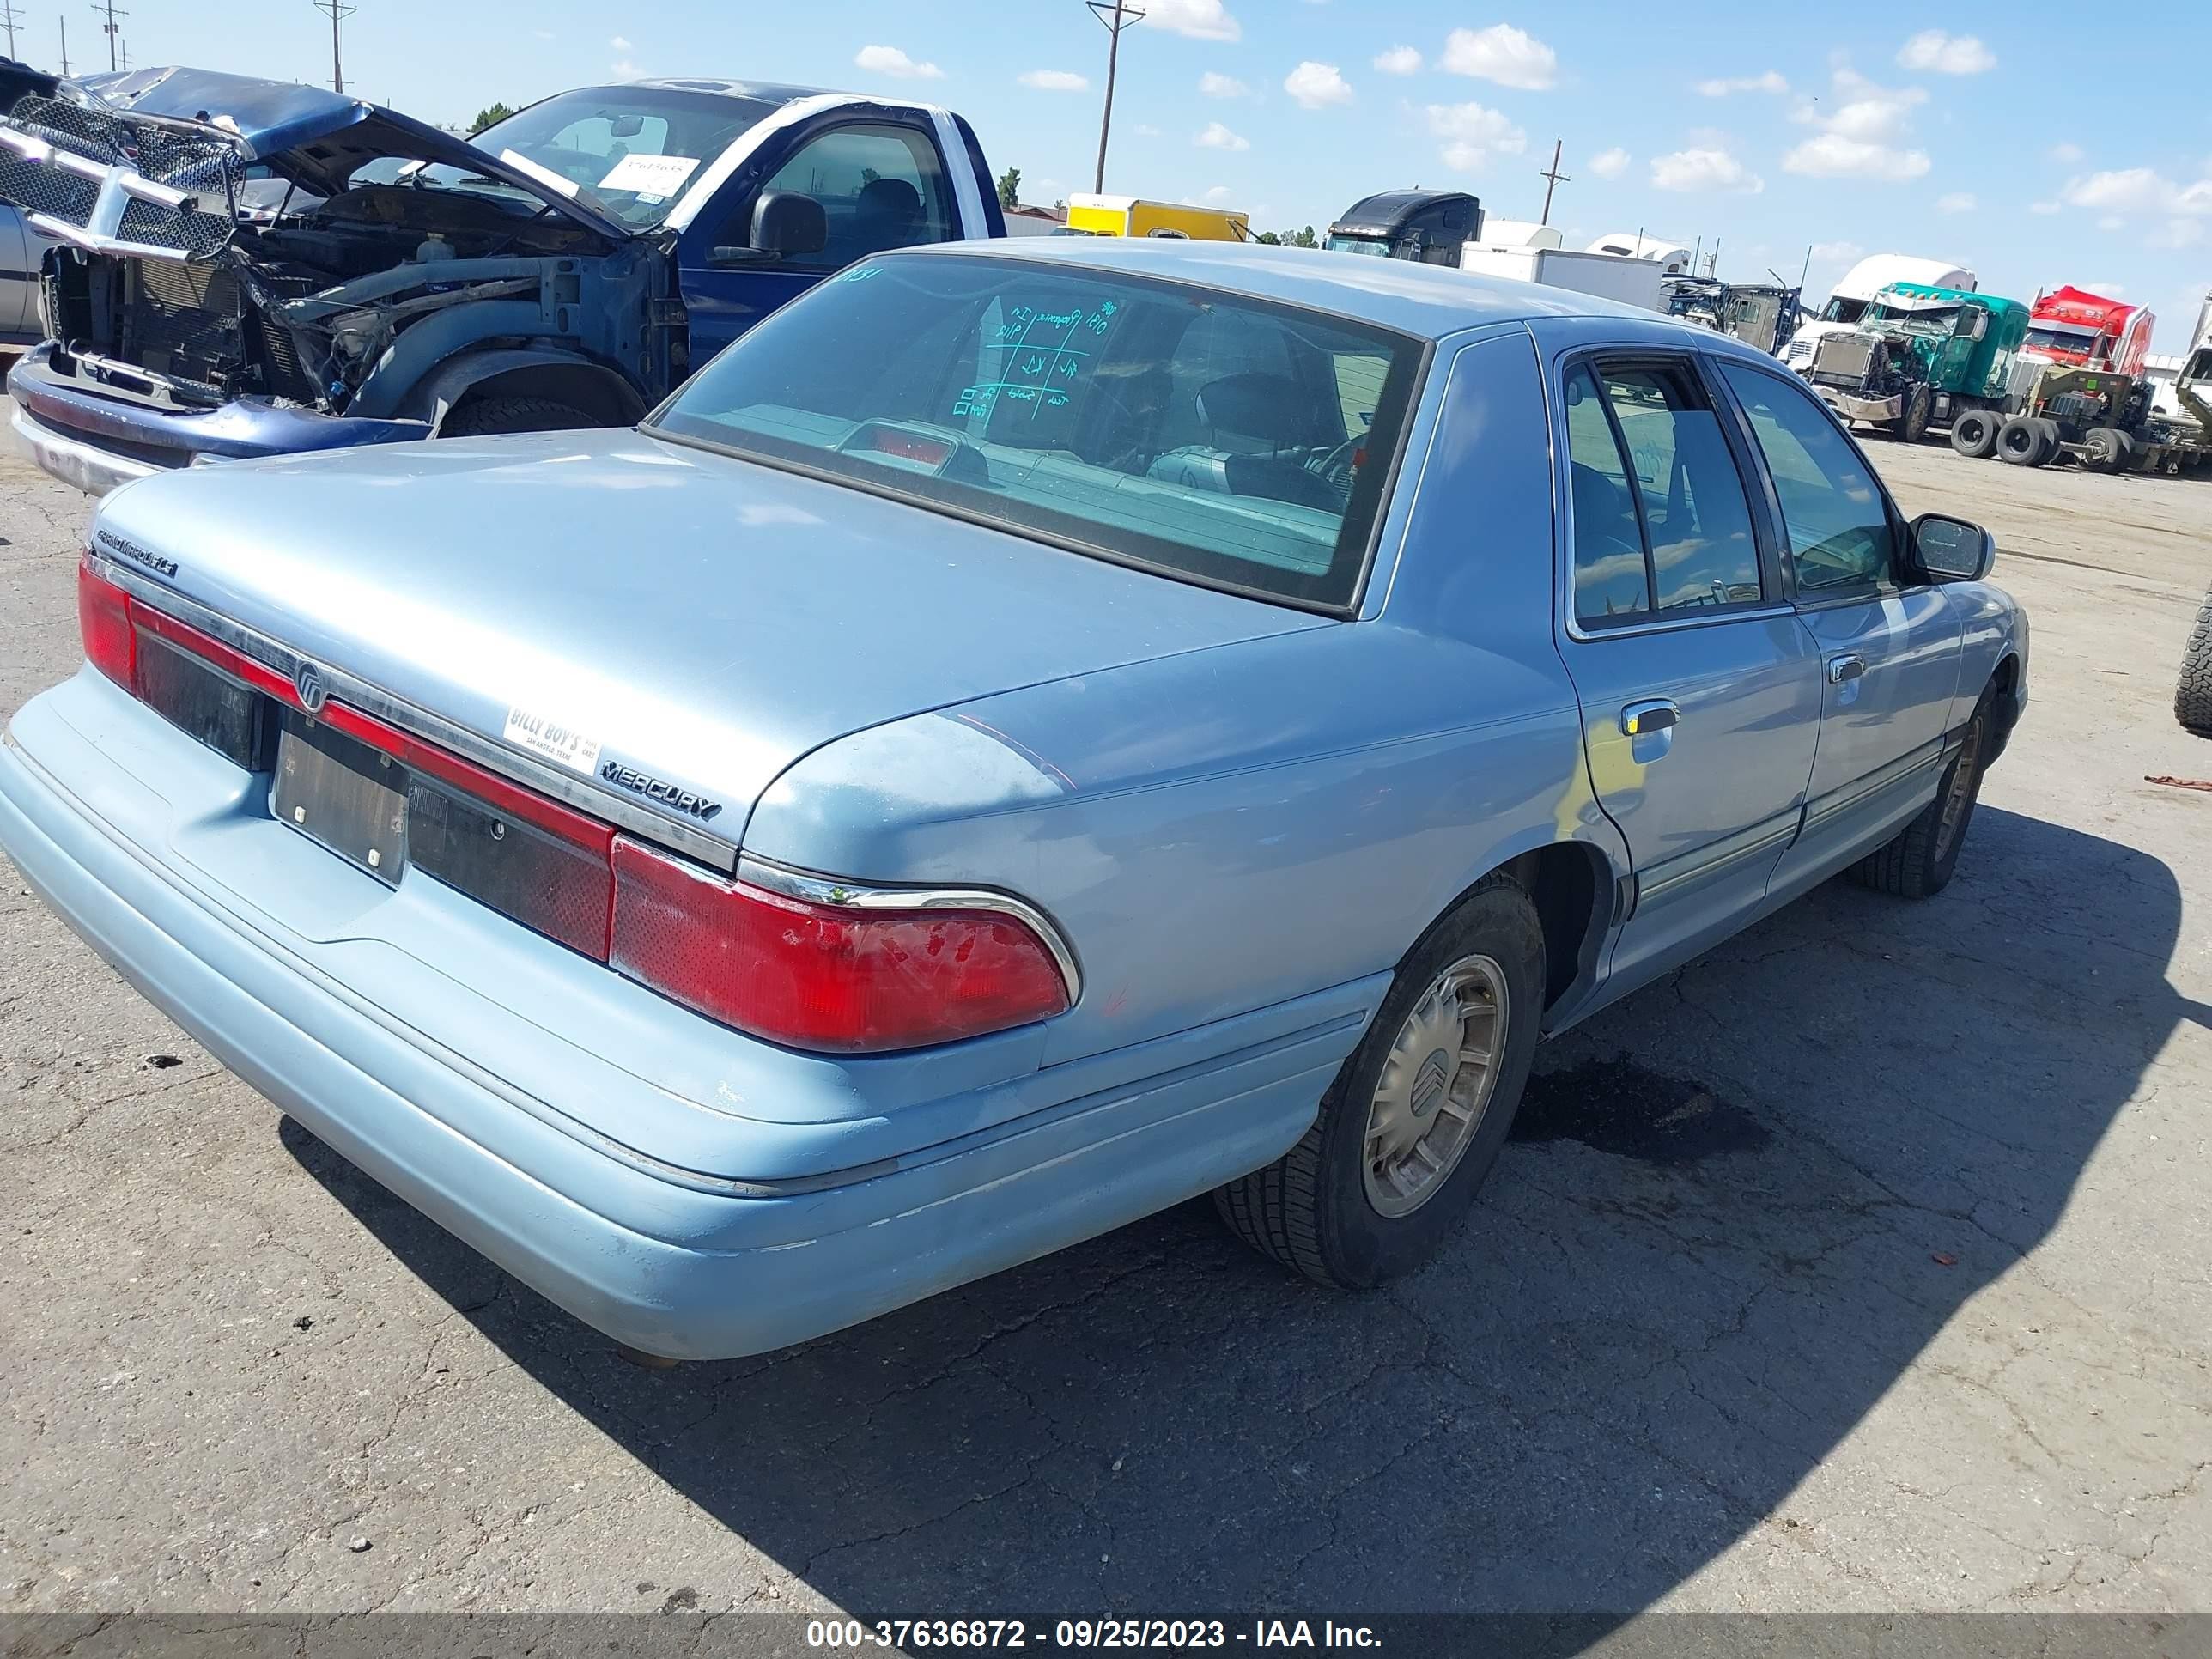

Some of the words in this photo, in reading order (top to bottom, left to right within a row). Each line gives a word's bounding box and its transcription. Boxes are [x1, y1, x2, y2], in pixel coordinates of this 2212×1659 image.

[510, 707, 544, 736] BILLY
[544, 722, 582, 751] BOY'S
[526, 736, 537, 745] SAN
[556, 749, 571, 761] TEXAS
[582, 748, 596, 759] CARS
[600, 760, 722, 822] MERCURY
